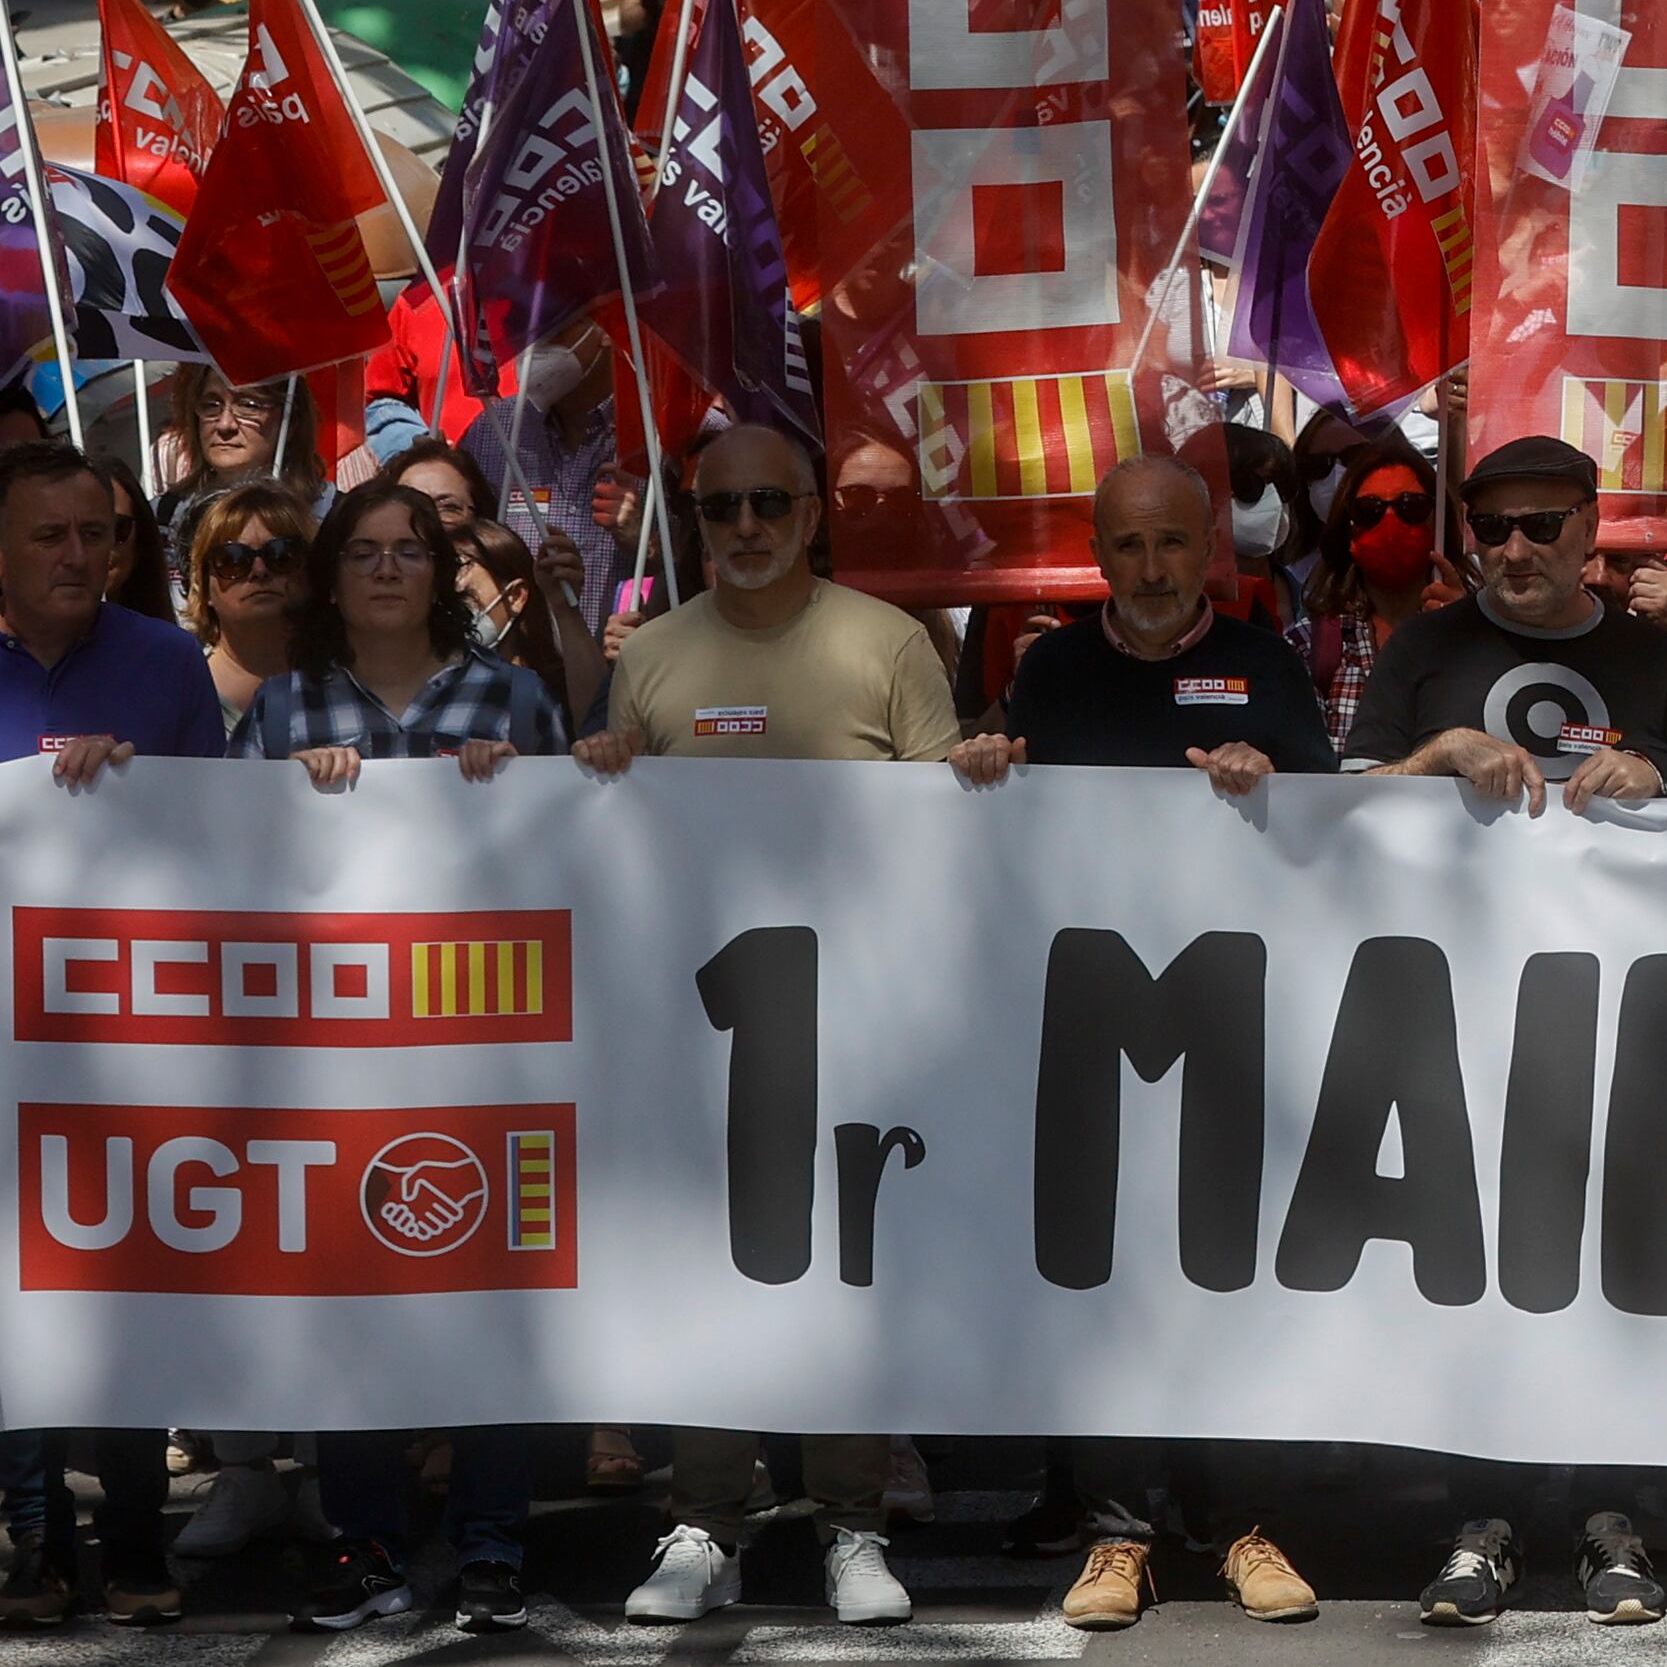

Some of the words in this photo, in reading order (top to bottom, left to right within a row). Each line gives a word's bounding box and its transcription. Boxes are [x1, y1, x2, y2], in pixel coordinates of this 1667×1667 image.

[1178, 679, 1225, 691] CCOO
[717, 721, 763, 733] CCOO
[1561, 724, 1605, 742] CCOO
[41, 937, 391, 1019] CCOO
[38, 1134, 337, 1255] UGT
